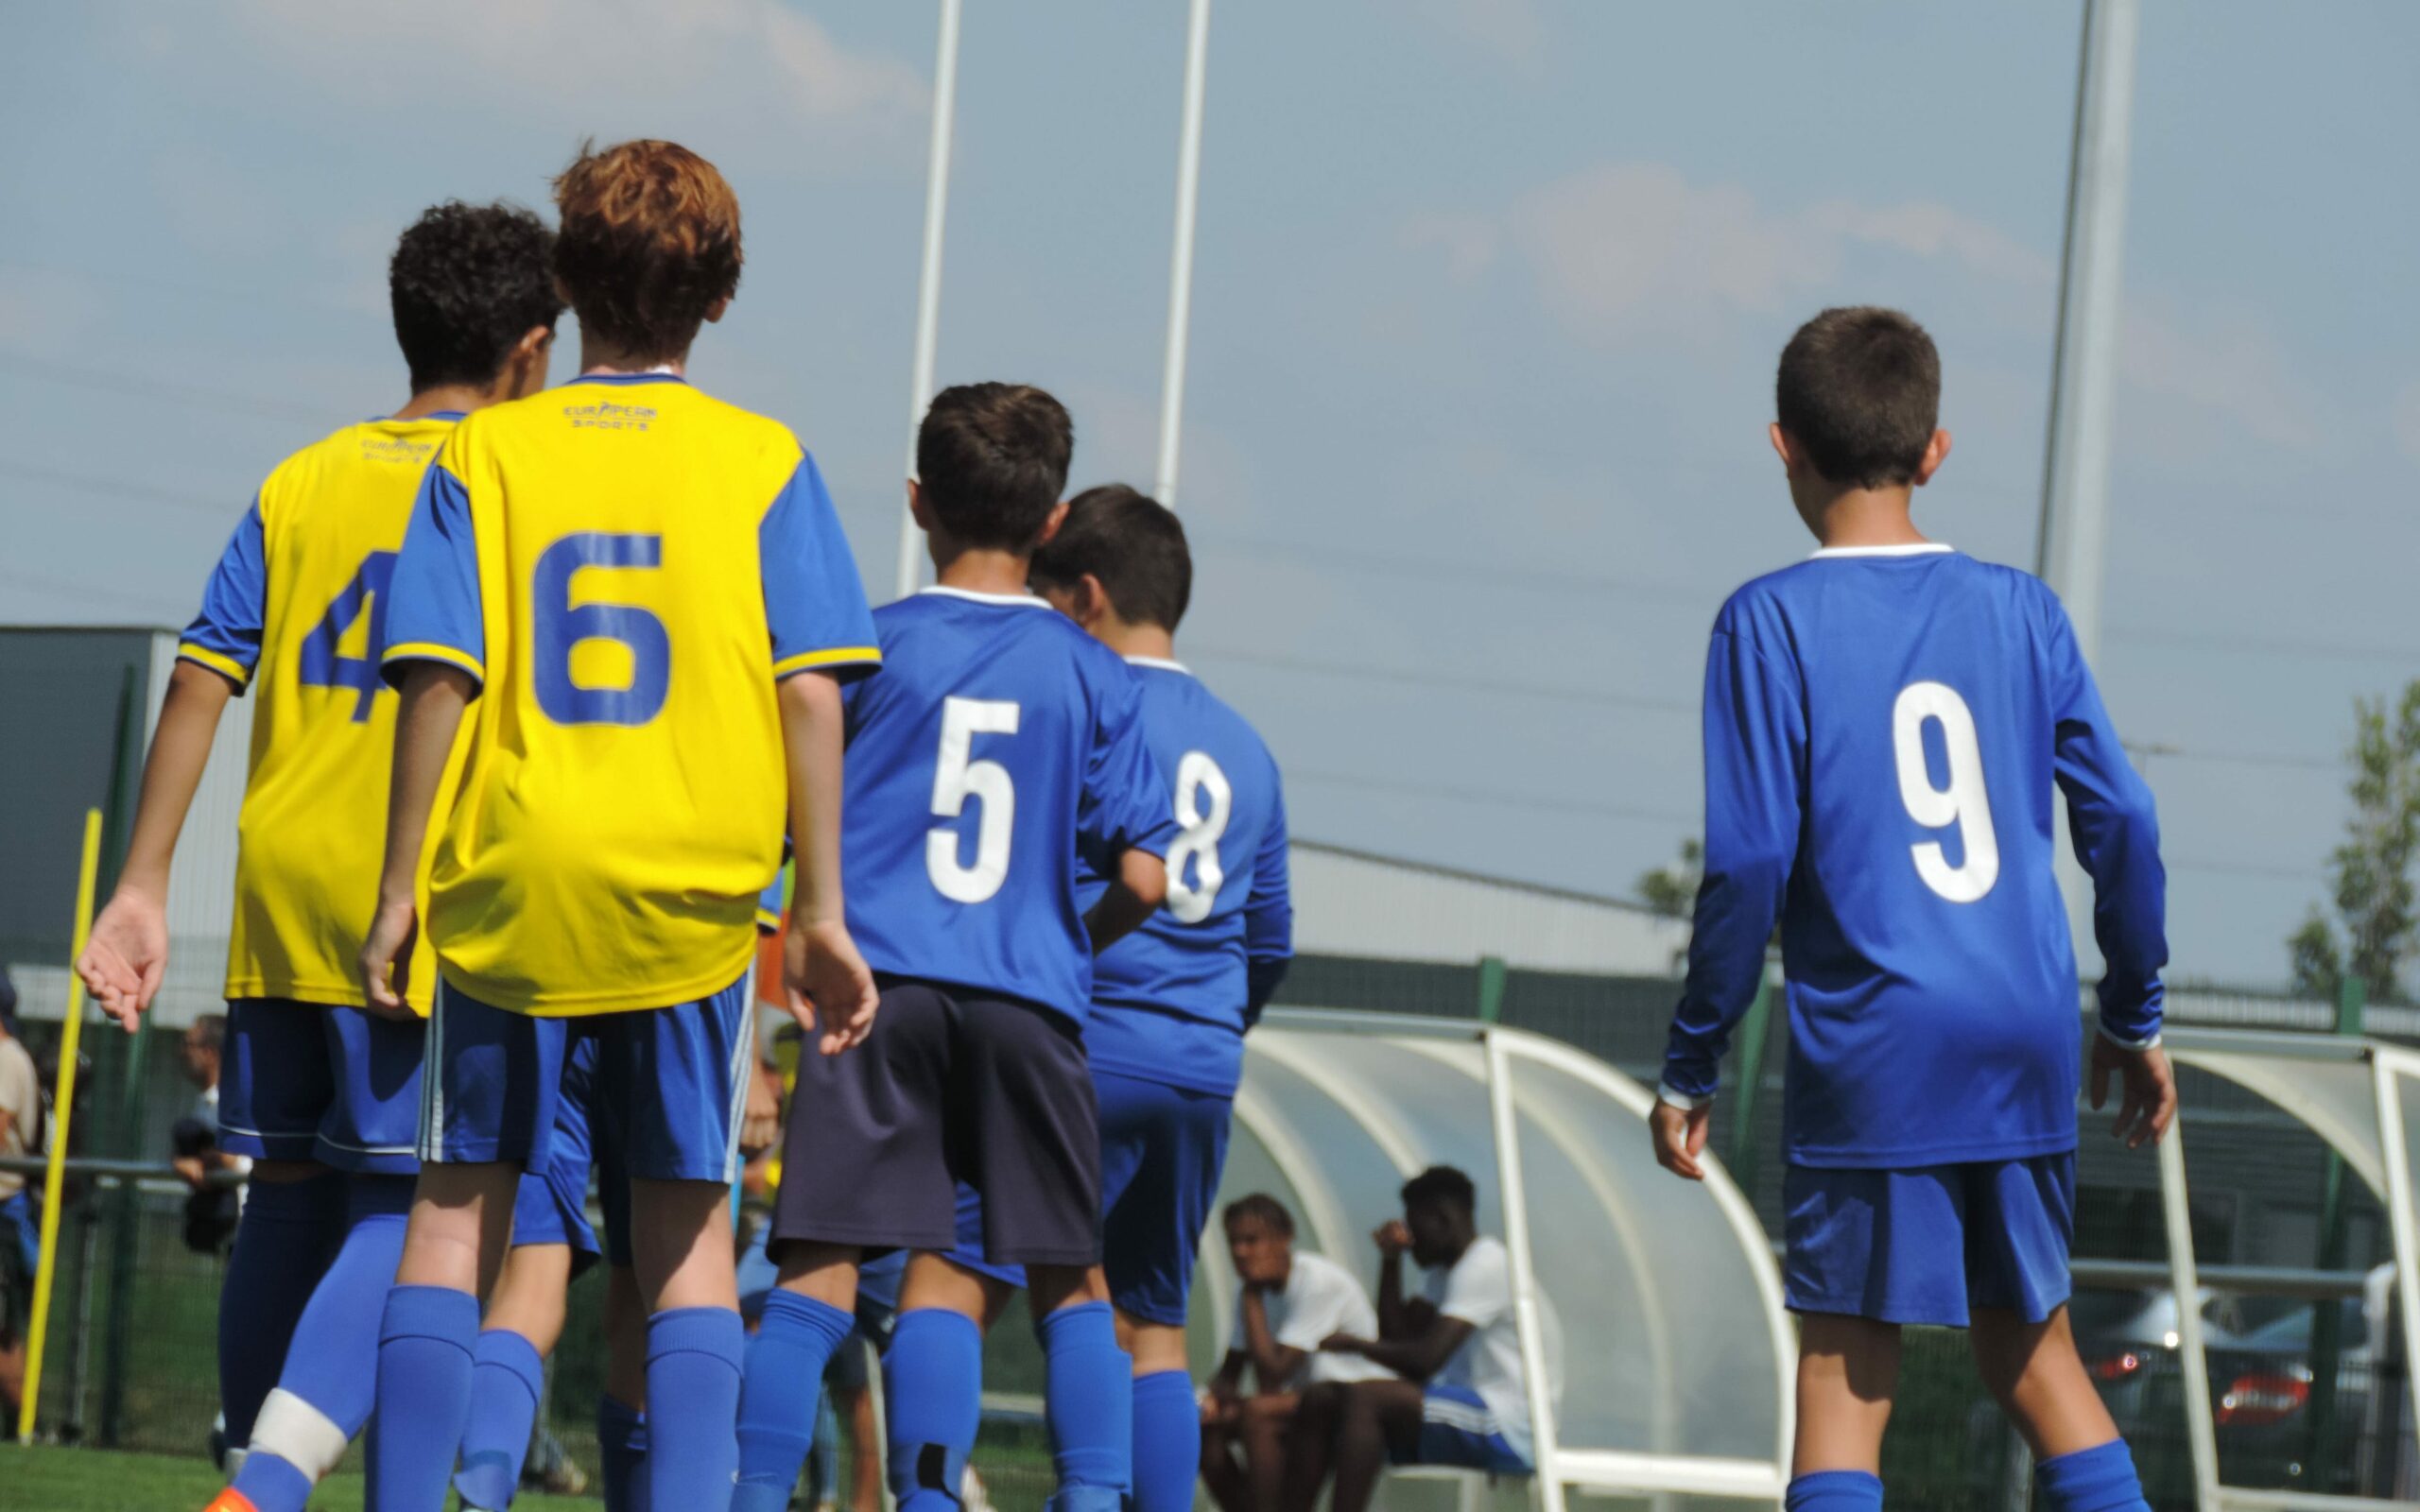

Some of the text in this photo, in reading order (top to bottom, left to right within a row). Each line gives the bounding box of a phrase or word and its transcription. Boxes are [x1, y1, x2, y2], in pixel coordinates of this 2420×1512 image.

[300, 549, 402, 723] 4
[532, 533, 670, 725] 6
[926, 696, 1020, 904] 5
[1165, 750, 1232, 923] 8
[1893, 680, 1999, 903] 9
